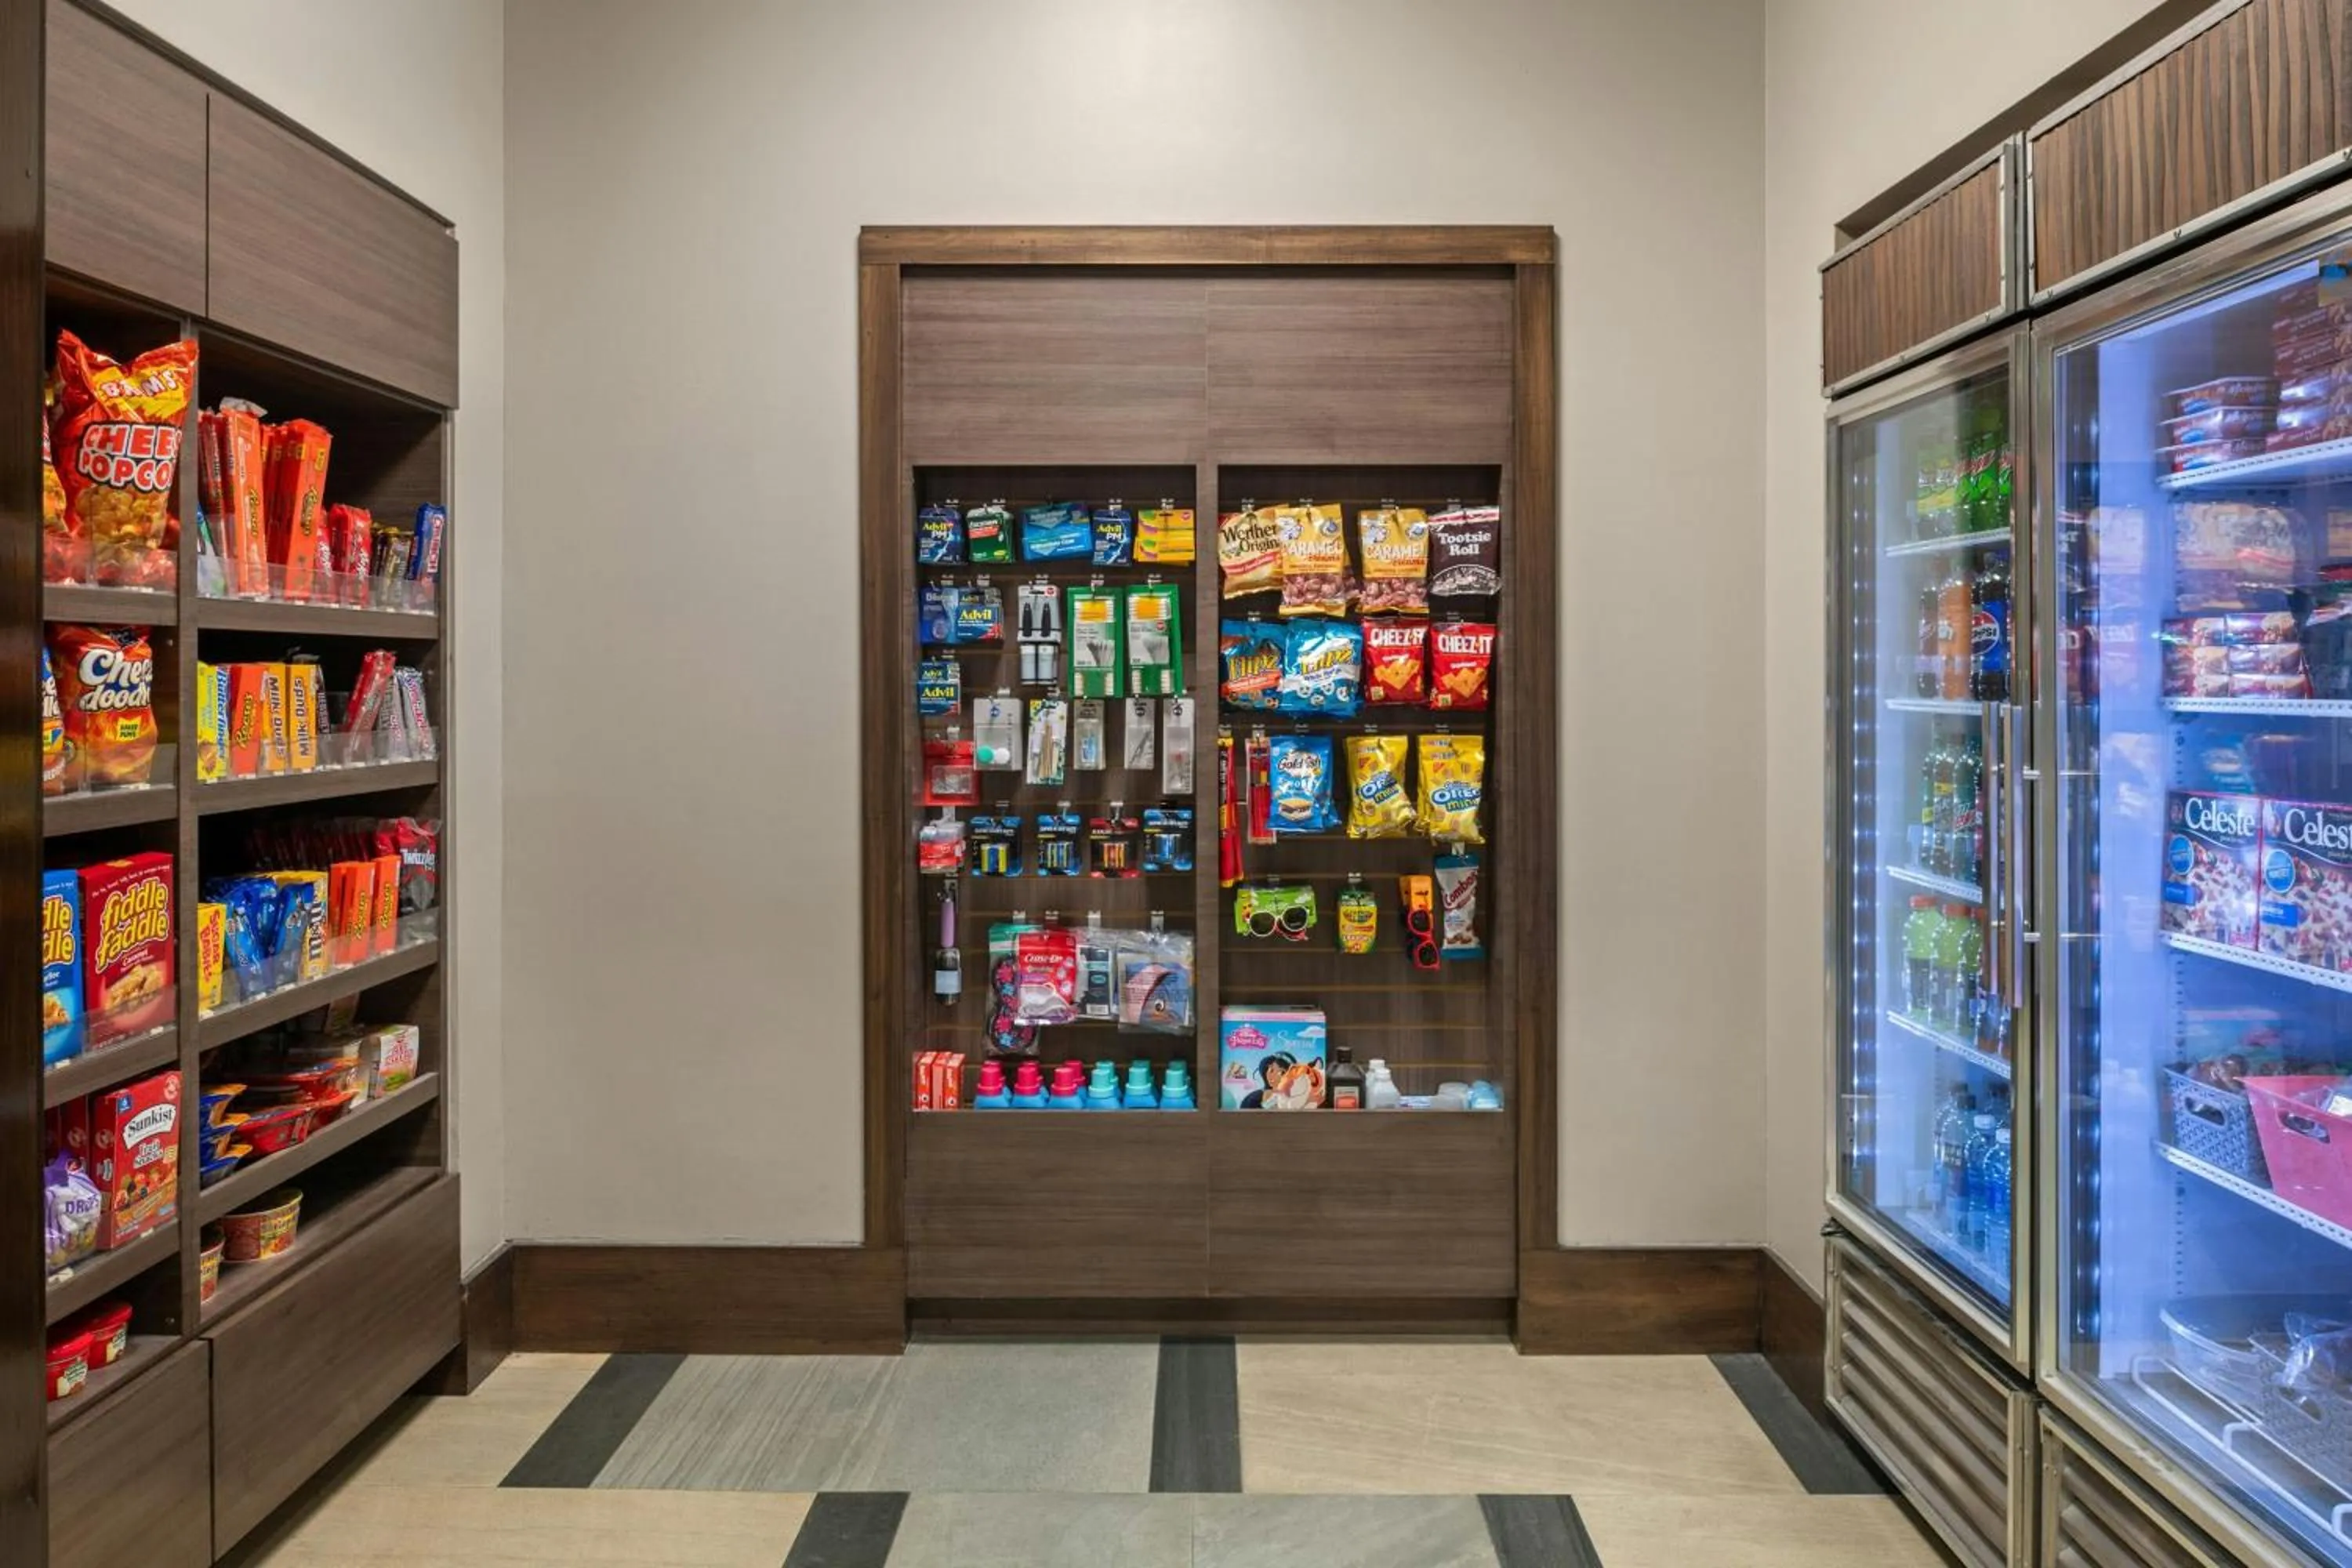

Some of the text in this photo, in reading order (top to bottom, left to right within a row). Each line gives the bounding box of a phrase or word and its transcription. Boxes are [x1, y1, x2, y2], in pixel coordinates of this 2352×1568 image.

[1097, 524, 1122, 533] Advil
[1437, 531, 1492, 545] Tootsie
[1449, 544, 1480, 556] Roll
[959, 608, 993, 620] Advil
[921, 686, 955, 698] Advil
[291, 677, 310, 757] Milk Duds
[2184, 796, 2256, 837] Celeste
[2284, 808, 2352, 851] Celes
[103, 877, 168, 931] fiddle
[96, 909, 168, 972] faddle
[127, 1106, 173, 1138] Sunkist
